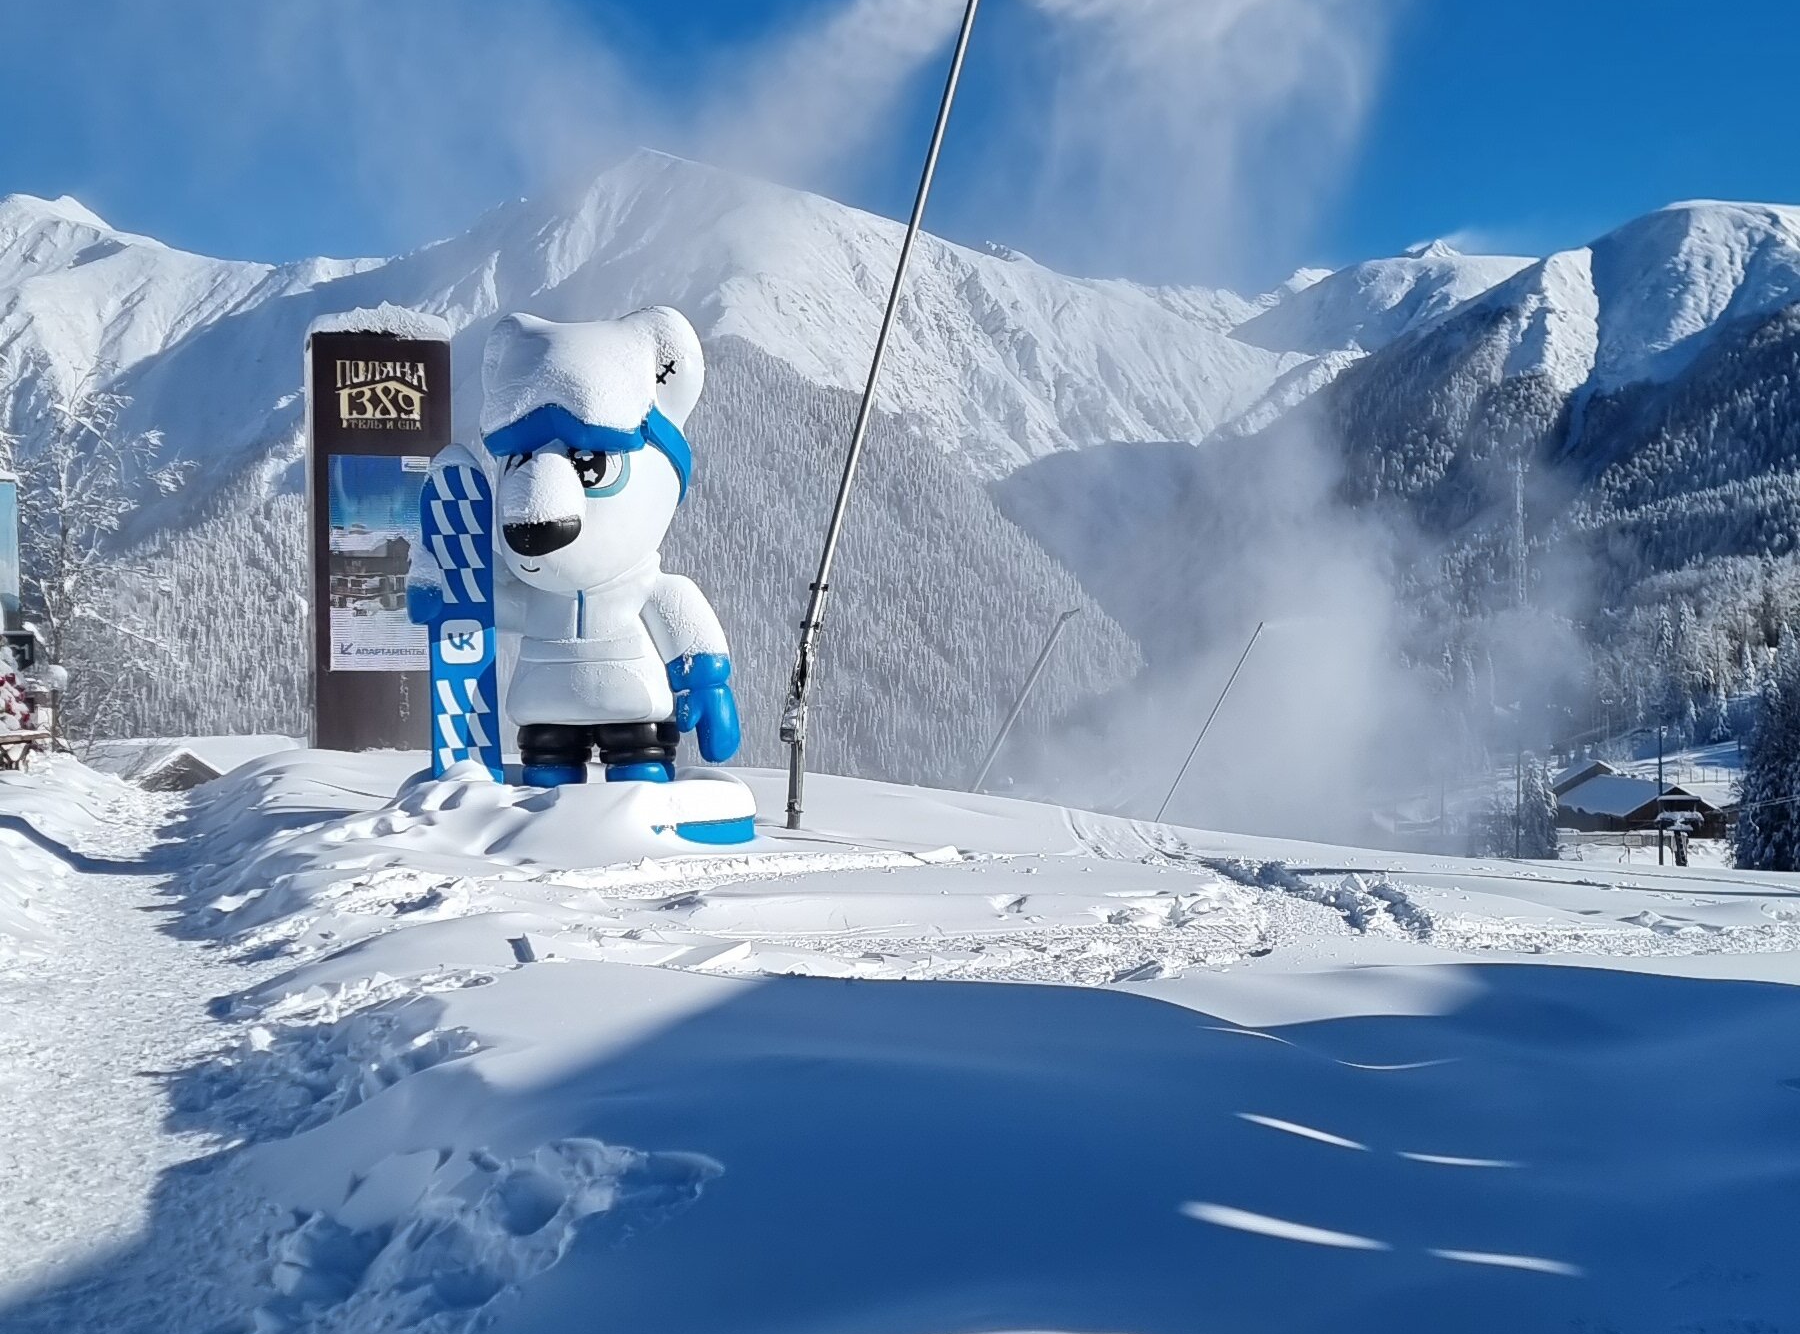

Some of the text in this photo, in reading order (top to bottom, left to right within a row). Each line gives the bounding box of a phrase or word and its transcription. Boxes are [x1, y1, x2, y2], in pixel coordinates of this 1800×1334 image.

[336, 359, 428, 392] ПОЛЯНА
[340, 385, 421, 420] 1389
[386, 420, 394, 430] И
[398, 420, 422, 431] СПА
[355, 648, 426, 656] АПАРТАМЕНТЫ
